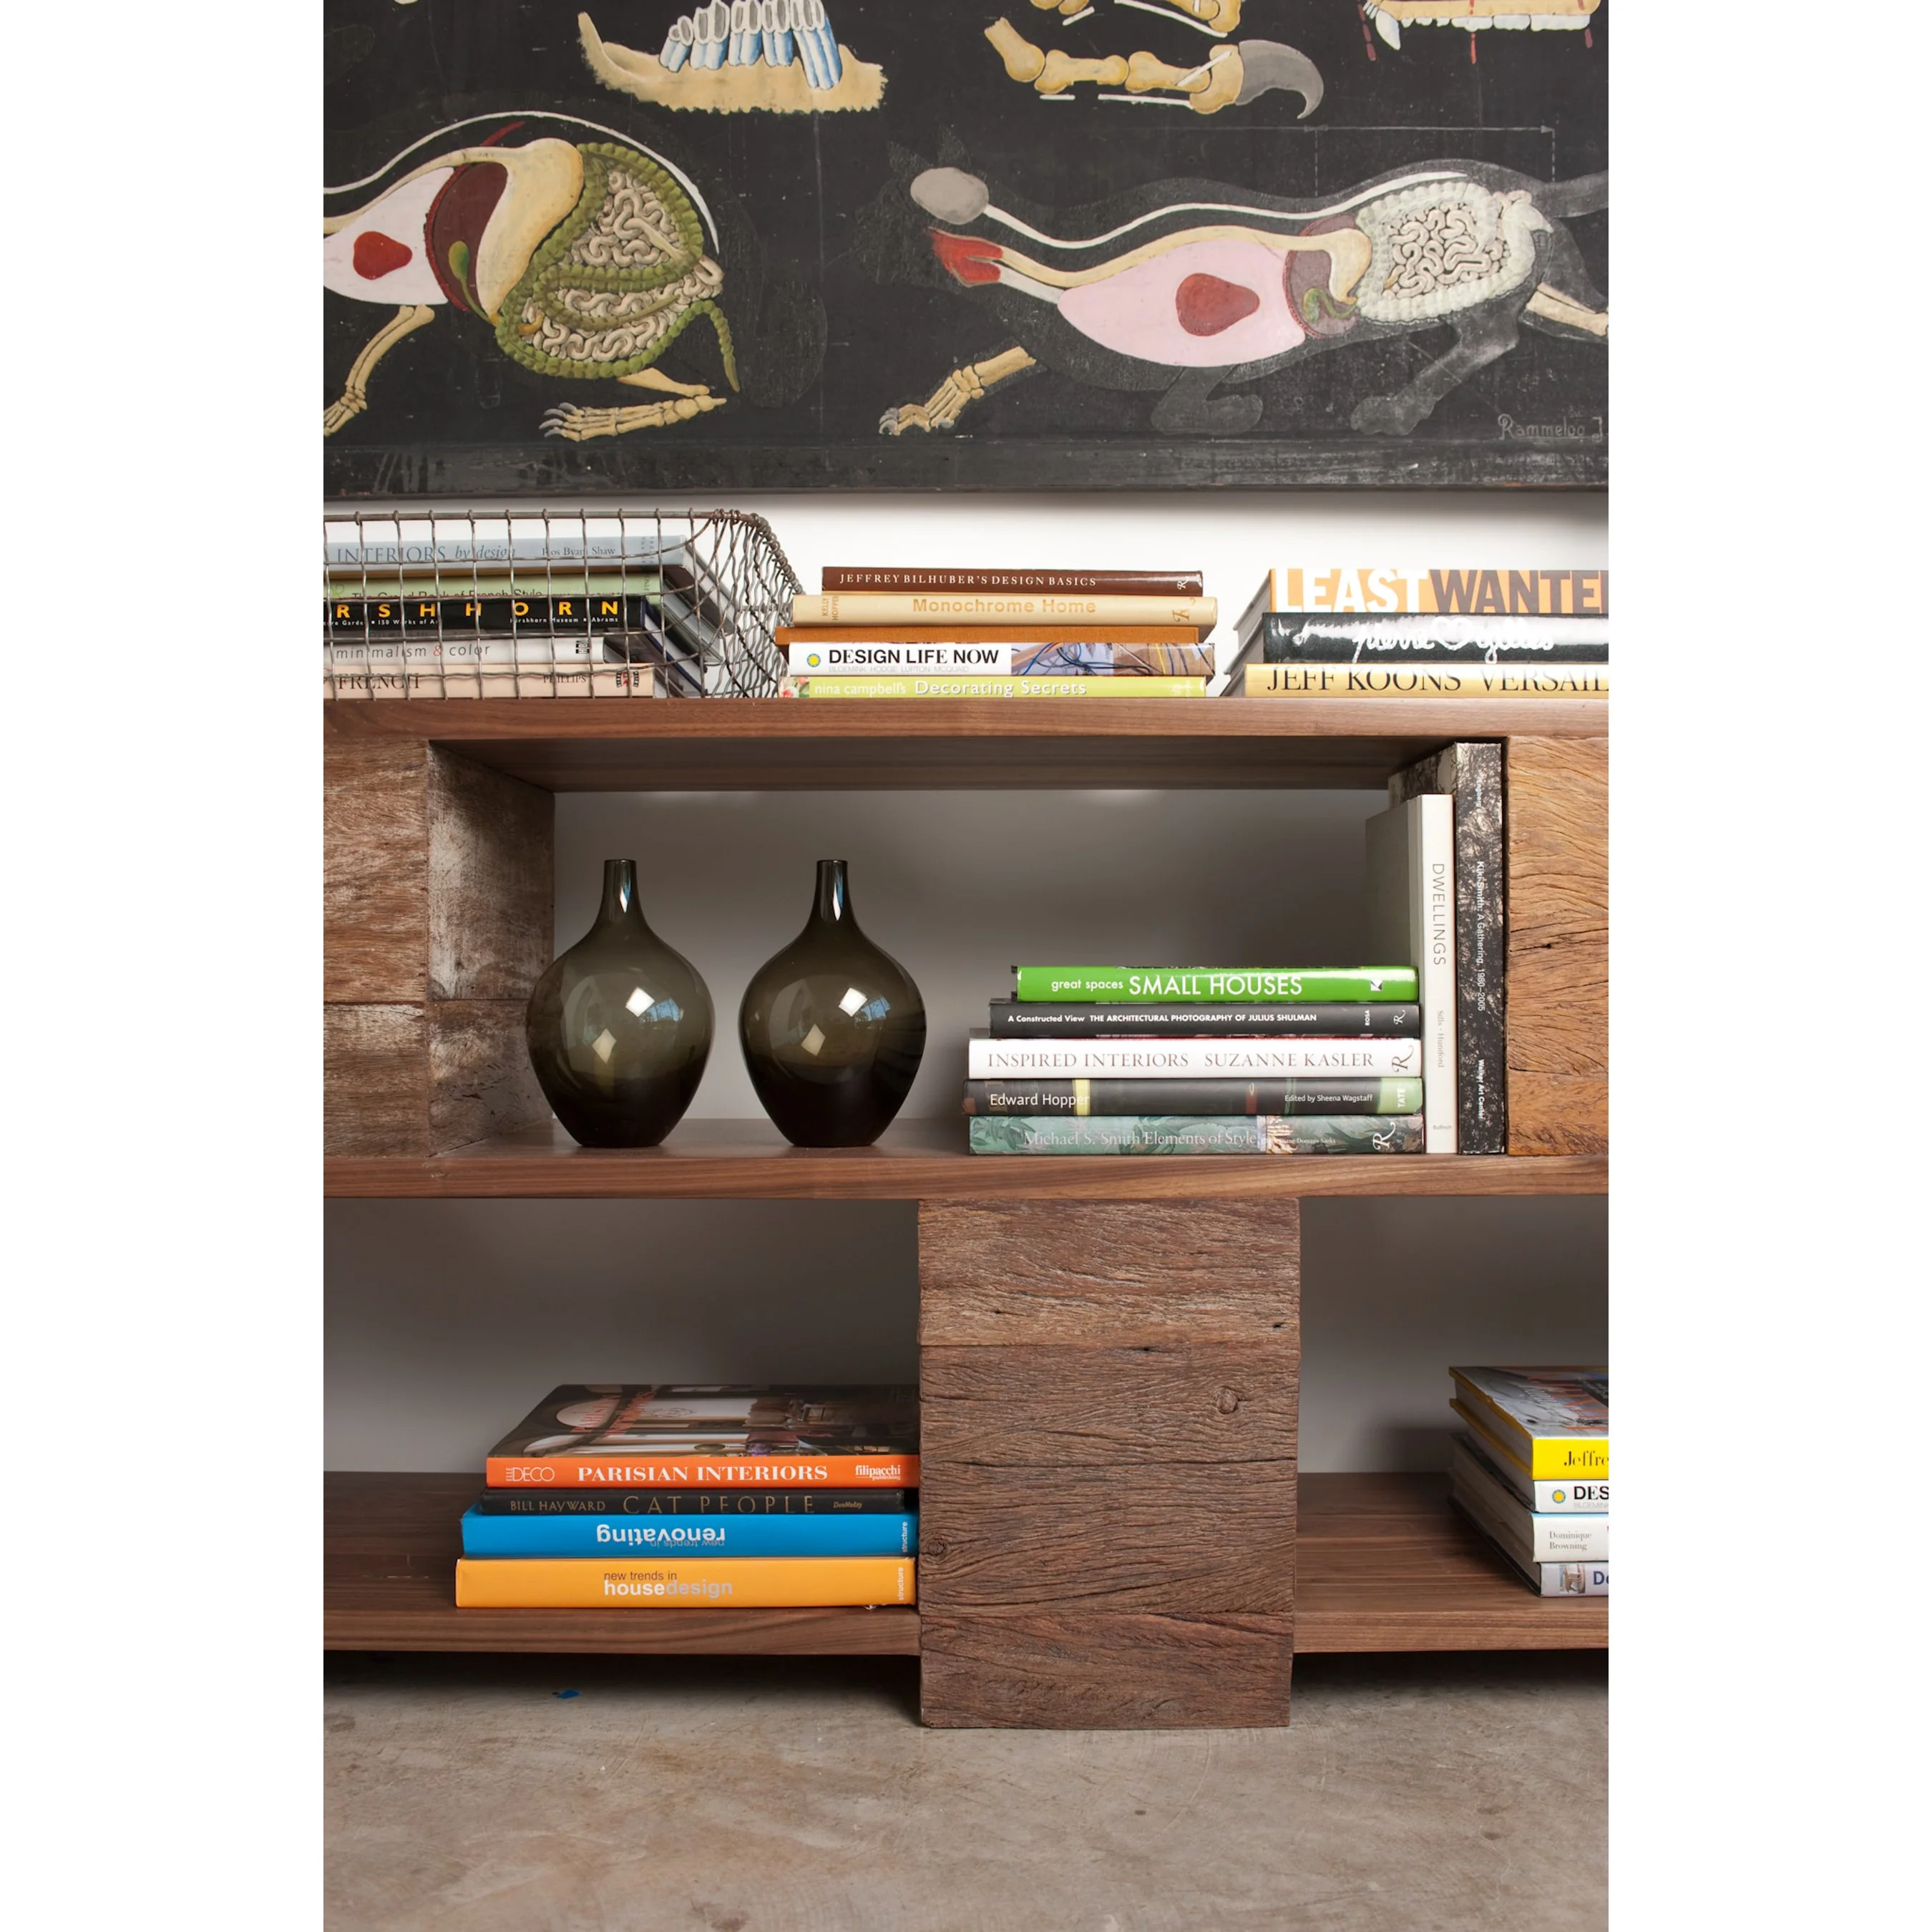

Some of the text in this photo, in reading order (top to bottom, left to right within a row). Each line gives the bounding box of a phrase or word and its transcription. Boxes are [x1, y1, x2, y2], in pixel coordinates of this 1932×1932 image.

[337, 545, 447, 562] INTERIORS
[455, 545, 471, 559] by
[592, 545, 615, 555] Shaw
[839, 574, 1097, 587] JEFFREY BILHUBER'S DESIGN BASICS
[1275, 569, 1429, 613] LEAST
[913, 598, 1097, 613] Monochrome Home
[336, 645, 426, 659] minmalism
[449, 643, 490, 656] color
[829, 649, 1000, 664] DESIGN LIFE NOW
[1267, 668, 1336, 691] JEFF
[1346, 668, 1462, 691] KOONS
[814, 683, 840, 694] nina
[915, 680, 1014, 698] Decorating
[1020, 680, 1087, 696] Secrets
[1476, 861, 1485, 879] Kiki
[1433, 863, 1446, 965] DWELLINGS
[1051, 975, 1303, 995] great spaces SMALL HOUSES
[1016, 1015, 1063, 1023] Constructed
[1064, 1014, 1085, 1023] View
[988, 1053, 1375, 1067] INSPIRED INTERIORS SUZANNE KASLER
[990, 1093, 1091, 1108] Edward Hopper
[1307, 1094, 1316, 1103] by
[1342, 1094, 1373, 1103] Wagstaff
[1024, 1131, 1078, 1146] Michael
[1083, 1132, 1096, 1145] S.
[1101, 1131, 1140, 1145] Smith
[1145, 1131, 1209, 1145] Elements
[1211, 1131, 1223, 1144] of
[1224, 1131, 1257, 1146] Style
[512, 1467, 555, 1482] DECO
[577, 1465, 828, 1481] PARISIAN INTERIORS
[855, 1464, 901, 1478] filipacchi
[510, 1500, 606, 1512] BILL HAYWARD
[623, 1496, 816, 1514] CAT PEOPLE
[596, 1523, 726, 1546] renovating
[1549, 1530, 1592, 1541] Dominique
[1549, 1541, 1587, 1551] Browning
[604, 1570, 678, 1581] new trends in
